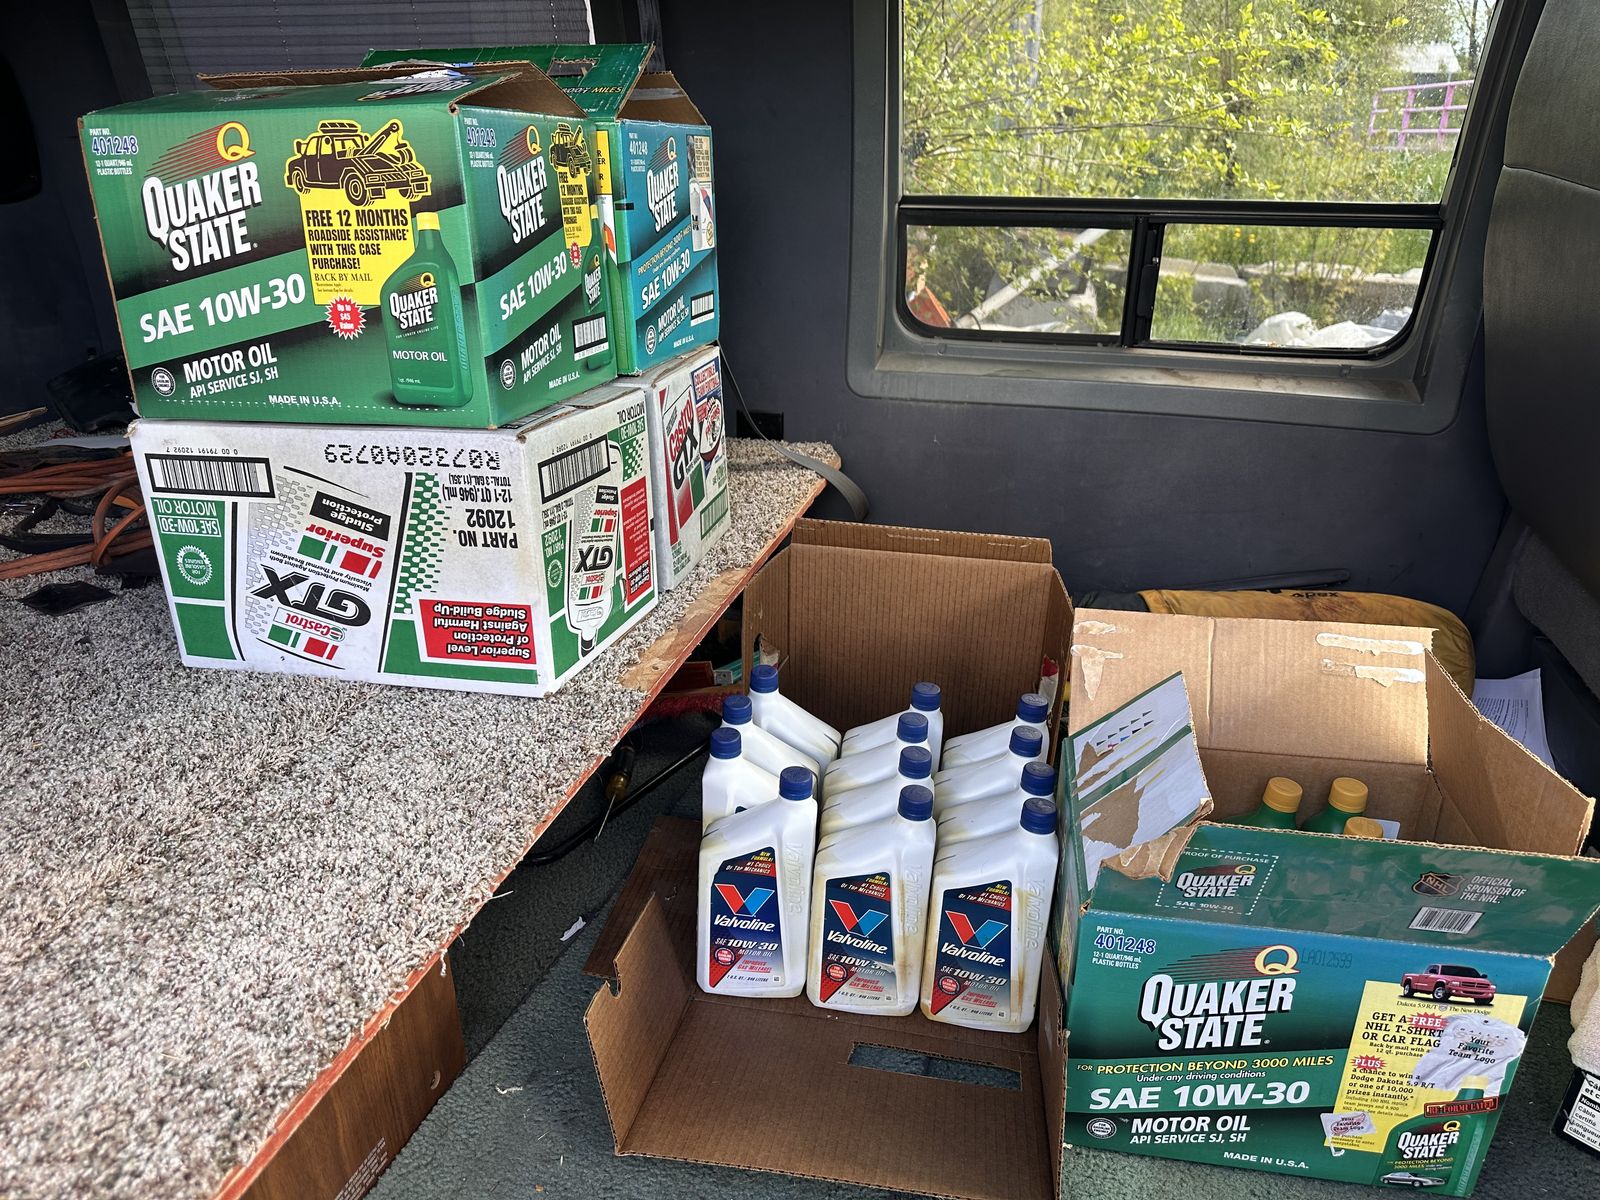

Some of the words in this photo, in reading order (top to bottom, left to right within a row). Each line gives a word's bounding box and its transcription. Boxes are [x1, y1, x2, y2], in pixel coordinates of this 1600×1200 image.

[89, 128, 102, 136] PART
[102, 128, 111, 136] NO.
[92, 135, 138, 156] 401248
[216, 121, 256, 161] Q
[497, 156, 548, 222] QUAKER
[647, 162, 679, 212] QUAKER
[141, 161, 263, 246] QUAKER
[654, 190, 677, 233] STATE
[305, 210, 333, 227] FREE
[336, 210, 352, 226] 12
[355, 208, 409, 226] MONTHS
[510, 193, 546, 244] STATE
[169, 210, 252, 271] STATE
[308, 229, 352, 242] ROADSIDE
[310, 244, 334, 256] WITH
[336, 244, 356, 256] THIS
[360, 244, 382, 256] CASE
[312, 258, 361, 270] PURCHASE!
[314, 273, 336, 282] BACK
[338, 274, 349, 282] BY
[351, 274, 373, 282] MAIL
[642, 276, 660, 310] SAE
[662, 248, 690, 290] 10W-30
[500, 282, 526, 320] SAE
[528, 252, 567, 299] 10W-30
[140, 303, 194, 343] SAE
[199, 274, 306, 327] 10W-30
[390, 287, 438, 318] QUAKER
[400, 306, 434, 330] STATE
[520, 333, 549, 371] MOTOR
[550, 323, 562, 346] OIL
[183, 350, 246, 384] MOTOR
[248, 342, 278, 372] OIL
[392, 350, 430, 360] MOTOR
[431, 352, 448, 362] OIL
[190, 386, 207, 399] API
[208, 375, 248, 396] SERVICE
[250, 372, 264, 385] SJ,
[265, 366, 279, 381] SH
[268, 395, 297, 404] MADE
[300, 396, 310, 404] IN
[312, 396, 342, 406] U.S.A.
[617, 410, 627, 424] OIL
[628, 401, 644, 420] MOTOR
[669, 390, 694, 462] Castrol
[674, 414, 698, 490] GTX
[442, 484, 458, 501] mL)
[154, 500, 173, 514] OIL
[174, 502, 217, 516] MOTOR
[322, 498, 383, 526] Protection
[594, 508, 618, 517] Superior
[161, 518, 200, 534] 10W-30
[330, 510, 375, 532] Sludge
[466, 508, 516, 529] 12092
[202, 519, 218, 535] SAE
[305, 523, 386, 558] Superior
[453, 530, 478, 547] NO.
[482, 531, 518, 549] PART
[574, 545, 614, 573] GTX
[251, 564, 372, 626] GTX
[434, 603, 482, 616] Build-Up
[486, 607, 526, 620] Sludge
[285, 612, 331, 637] Castrol
[434, 618, 480, 630] Harmful
[482, 622, 528, 632] Against
[454, 632, 514, 645] Protection
[516, 636, 529, 646] of
[448, 644, 478, 656] Level
[480, 646, 530, 659] Superior
[1224, 855, 1270, 864] PURCHASE
[1176, 872, 1256, 890] QUAKER
[1426, 875, 1450, 894] NHL
[1471, 875, 1513, 888] OFFICIAL
[1184, 886, 1239, 898] STATE
[1460, 892, 1478, 901] THE
[1464, 884, 1511, 896] SPONSOR
[1512, 888, 1527, 897] OF
[1199, 902, 1234, 911] 10W-30
[714, 914, 776, 932] Valvoline
[1096, 925, 1112, 934] PART
[1112, 927, 1124, 935] NO.
[714, 938, 727, 946] SAE
[826, 930, 888, 955] Valvoline
[1094, 934, 1156, 954] 401248
[738, 949, 762, 957] MOTOR
[940, 942, 1006, 967] Valvoline
[1093, 950, 1104, 958] 12-1
[1254, 944, 1300, 976] Q
[940, 966, 952, 974] SAE
[1092, 958, 1114, 967] PLASTIC
[1115, 960, 1139, 970] BOTTLES
[1140, 974, 1296, 1028] QUAKER
[1372, 1012, 1396, 1021] GET
[1398, 1015, 1407, 1024] A
[1411, 1016, 1442, 1027] FREE
[1158, 1014, 1266, 1050] STATE
[1365, 1022, 1390, 1032] NHL
[1395, 1024, 1444, 1038] T-SHIRT
[1362, 1032, 1378, 1041] OR
[1382, 1034, 1406, 1044] CAR
[1410, 1036, 1441, 1048] FLAG
[1470, 1036, 1490, 1046] Your
[1448, 1048, 1472, 1059] Team
[1474, 1054, 1496, 1064] Logo
[1458, 1042, 1495, 1056] Favorite
[1077, 1064, 1093, 1072] FOR
[1097, 1062, 1184, 1074] PROTECTION
[1188, 1060, 1248, 1070] BEYOND
[1251, 1058, 1289, 1068] 3000
[1292, 1056, 1334, 1066] MILES
[1354, 1058, 1381, 1068] PLUS
[1136, 1074, 1165, 1083] Under
[1166, 1074, 1184, 1083] any
[1186, 1071, 1218, 1082] driving
[1220, 1070, 1266, 1079] conditions
[1350, 1074, 1375, 1083] Dodge
[1376, 1076, 1404, 1086] Dakota
[1089, 1086, 1162, 1110] SAE
[1173, 1081, 1310, 1108] 10W-30
[1584, 1086, 1594, 1096] et
[1578, 1106, 1596, 1119] Câble
[1130, 1116, 1210, 1134] MOTOR
[1216, 1115, 1251, 1132] OIL
[1130, 1134, 1151, 1144] API
[1154, 1134, 1206, 1144] SERVICE
[1208, 1134, 1226, 1144] SJ,
[1229, 1133, 1247, 1142] SH
[1398, 1131, 1460, 1150] QUAKER
[1568, 1126, 1586, 1139] câble
[1587, 1136, 1598, 1144] sur
[1402, 1144, 1448, 1159] STATE
[1223, 1152, 1257, 1161] MADE
[1260, 1156, 1272, 1164] IN
[1275, 1158, 1310, 1170] U.S.A.
